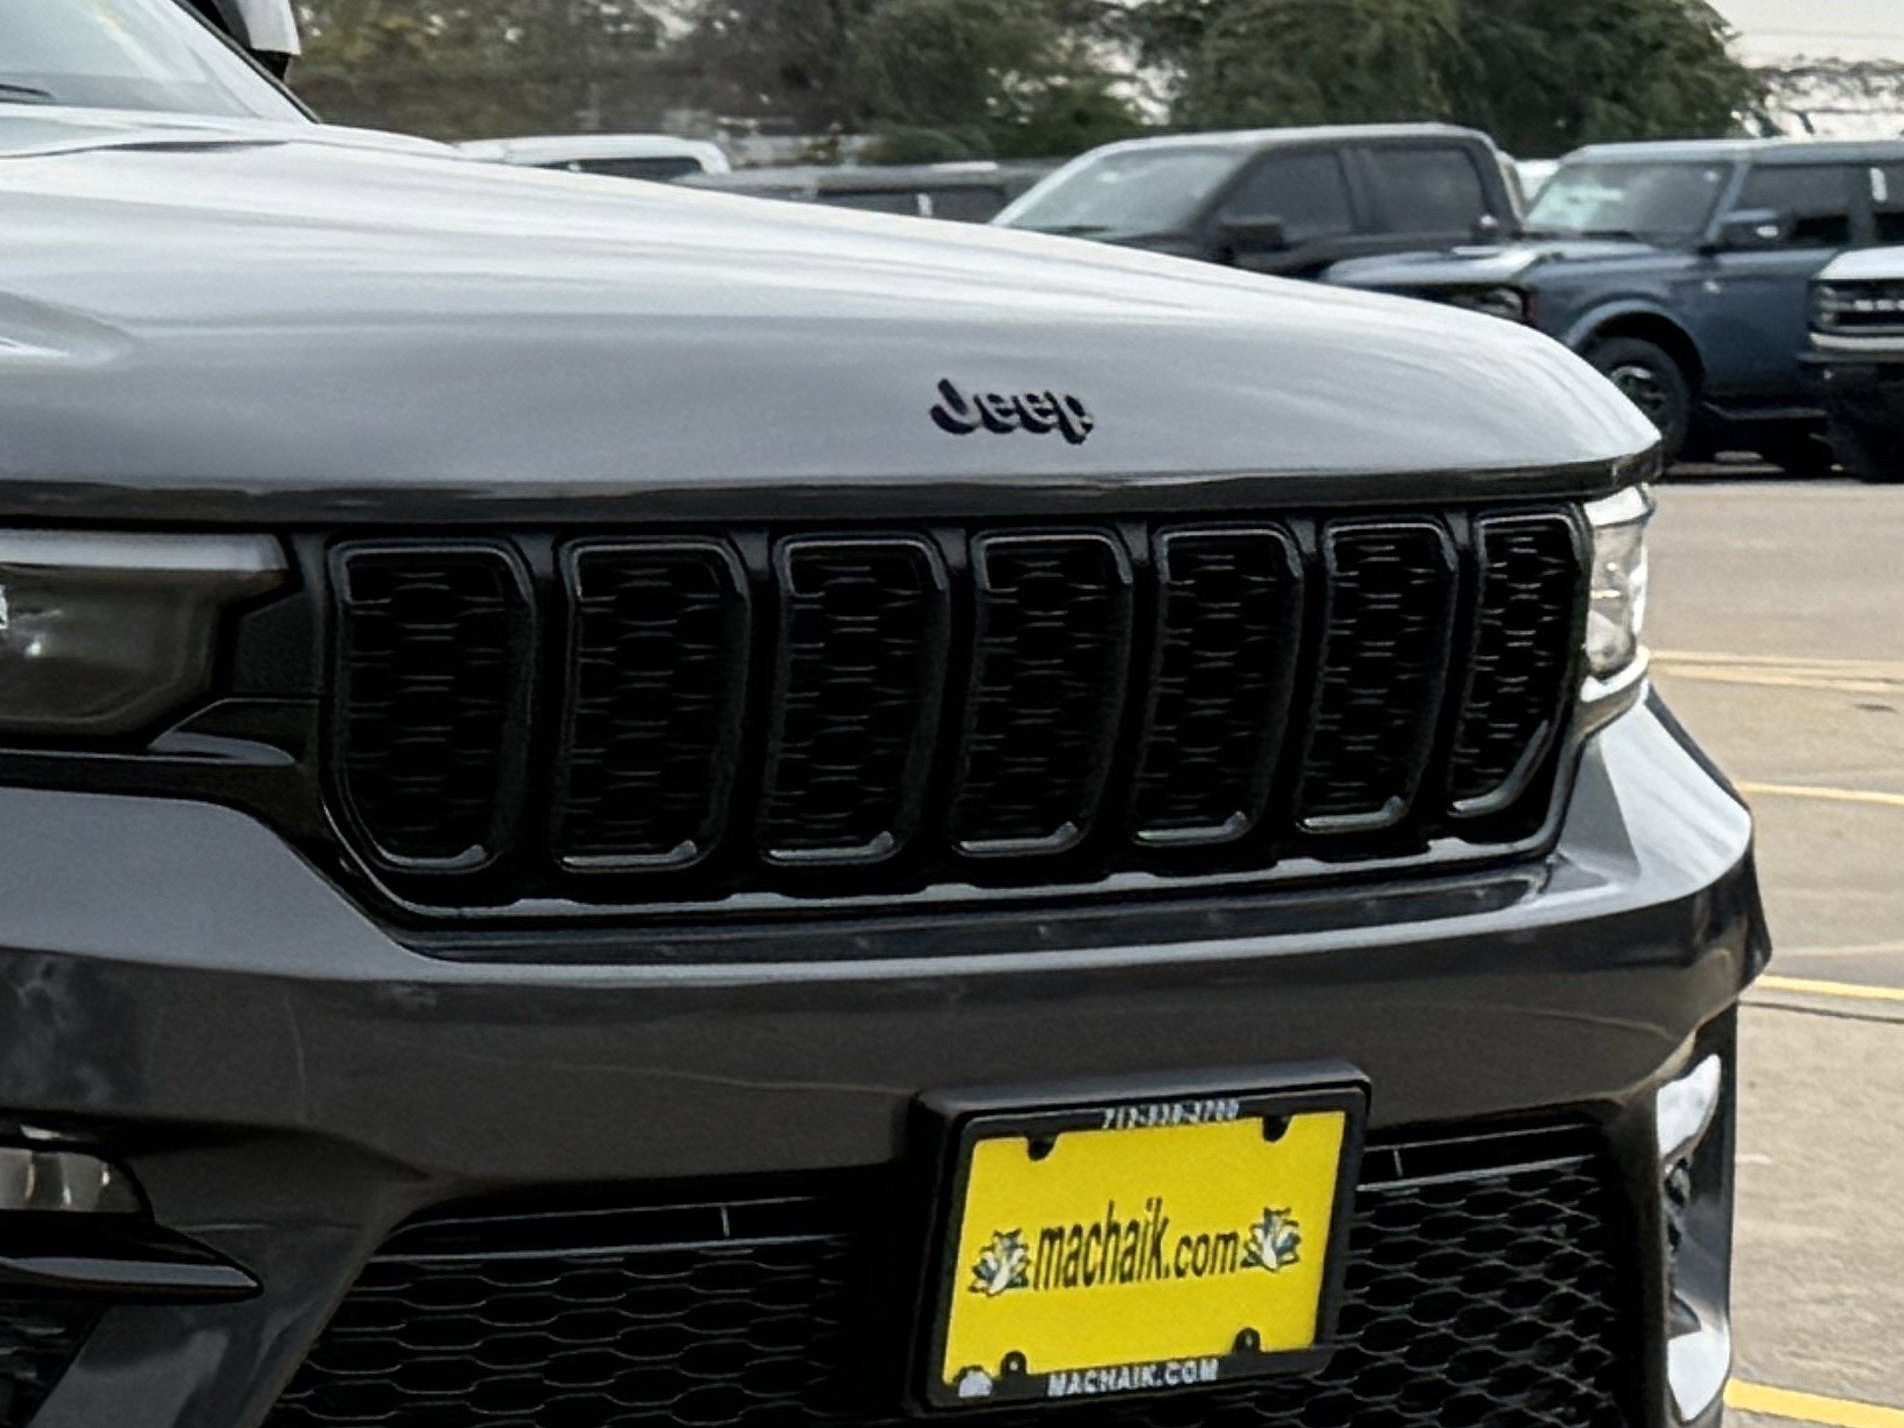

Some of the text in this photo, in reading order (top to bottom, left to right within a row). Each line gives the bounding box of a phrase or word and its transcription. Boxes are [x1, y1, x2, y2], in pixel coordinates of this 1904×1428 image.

[929, 378, 1094, 445] Jeep
[1033, 1195, 1240, 1291] machaik.com
[1047, 1357, 1219, 1398] MACHAIK.COM
